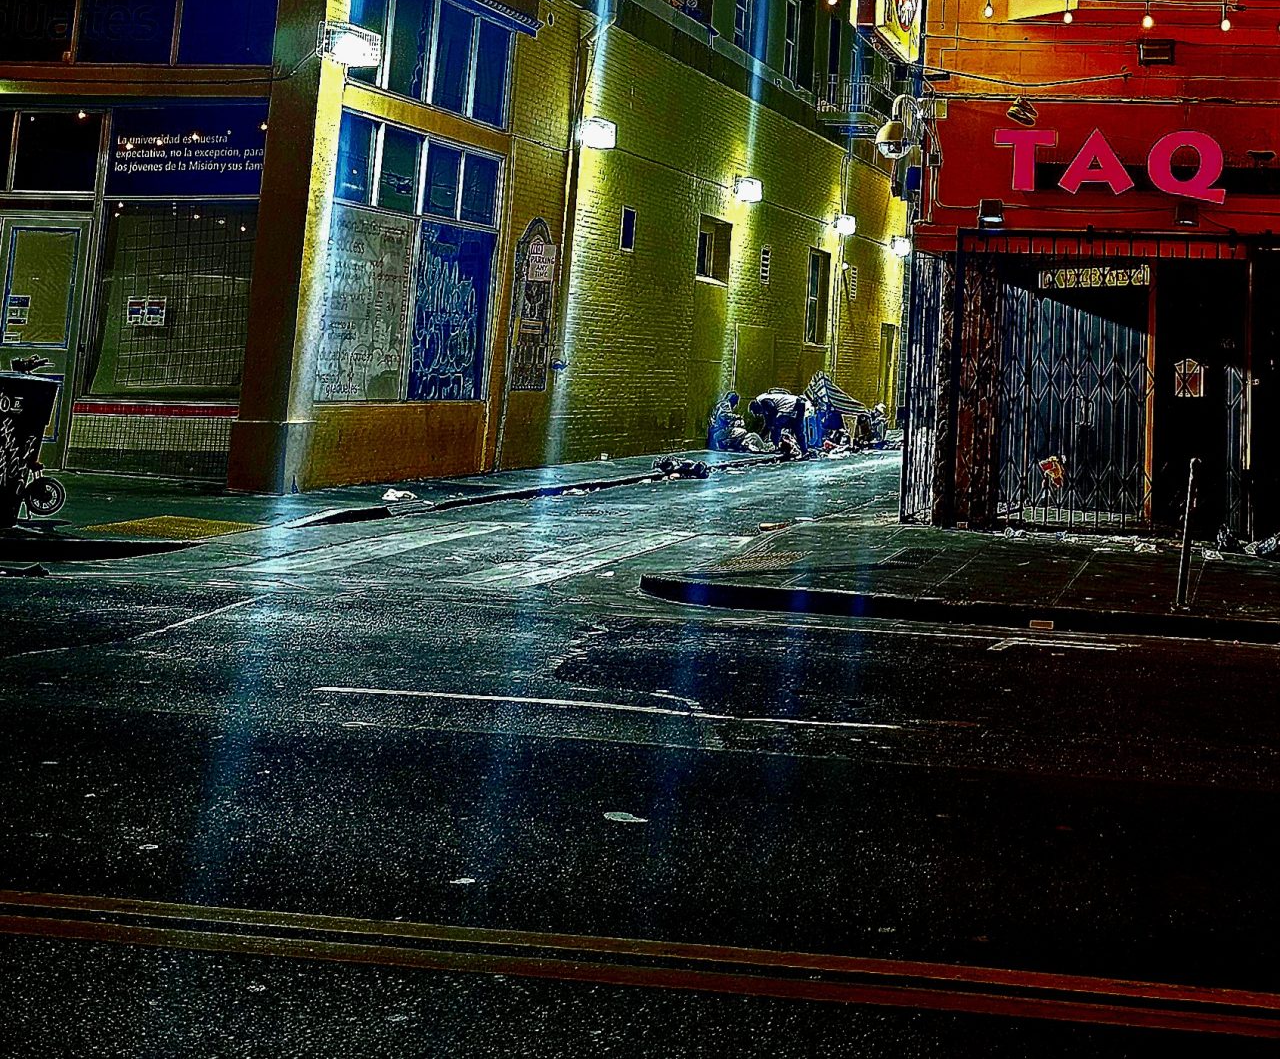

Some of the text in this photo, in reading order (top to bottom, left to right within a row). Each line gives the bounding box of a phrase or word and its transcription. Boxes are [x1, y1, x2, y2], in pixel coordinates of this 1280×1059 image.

[117, 135, 127, 145] La
[183, 135, 192, 144] es
[115, 146, 264, 160] expectativa, no la excepción, para
[114, 162, 127, 172] los
[165, 161, 177, 171] de
[178, 161, 186, 171] la
[188, 160, 219, 171] Misión
[219, 162, 228, 173] y
[227, 162, 243, 171] sus
[993, 127, 1226, 204] TAQ
[530, 256, 555, 265] PARKING
